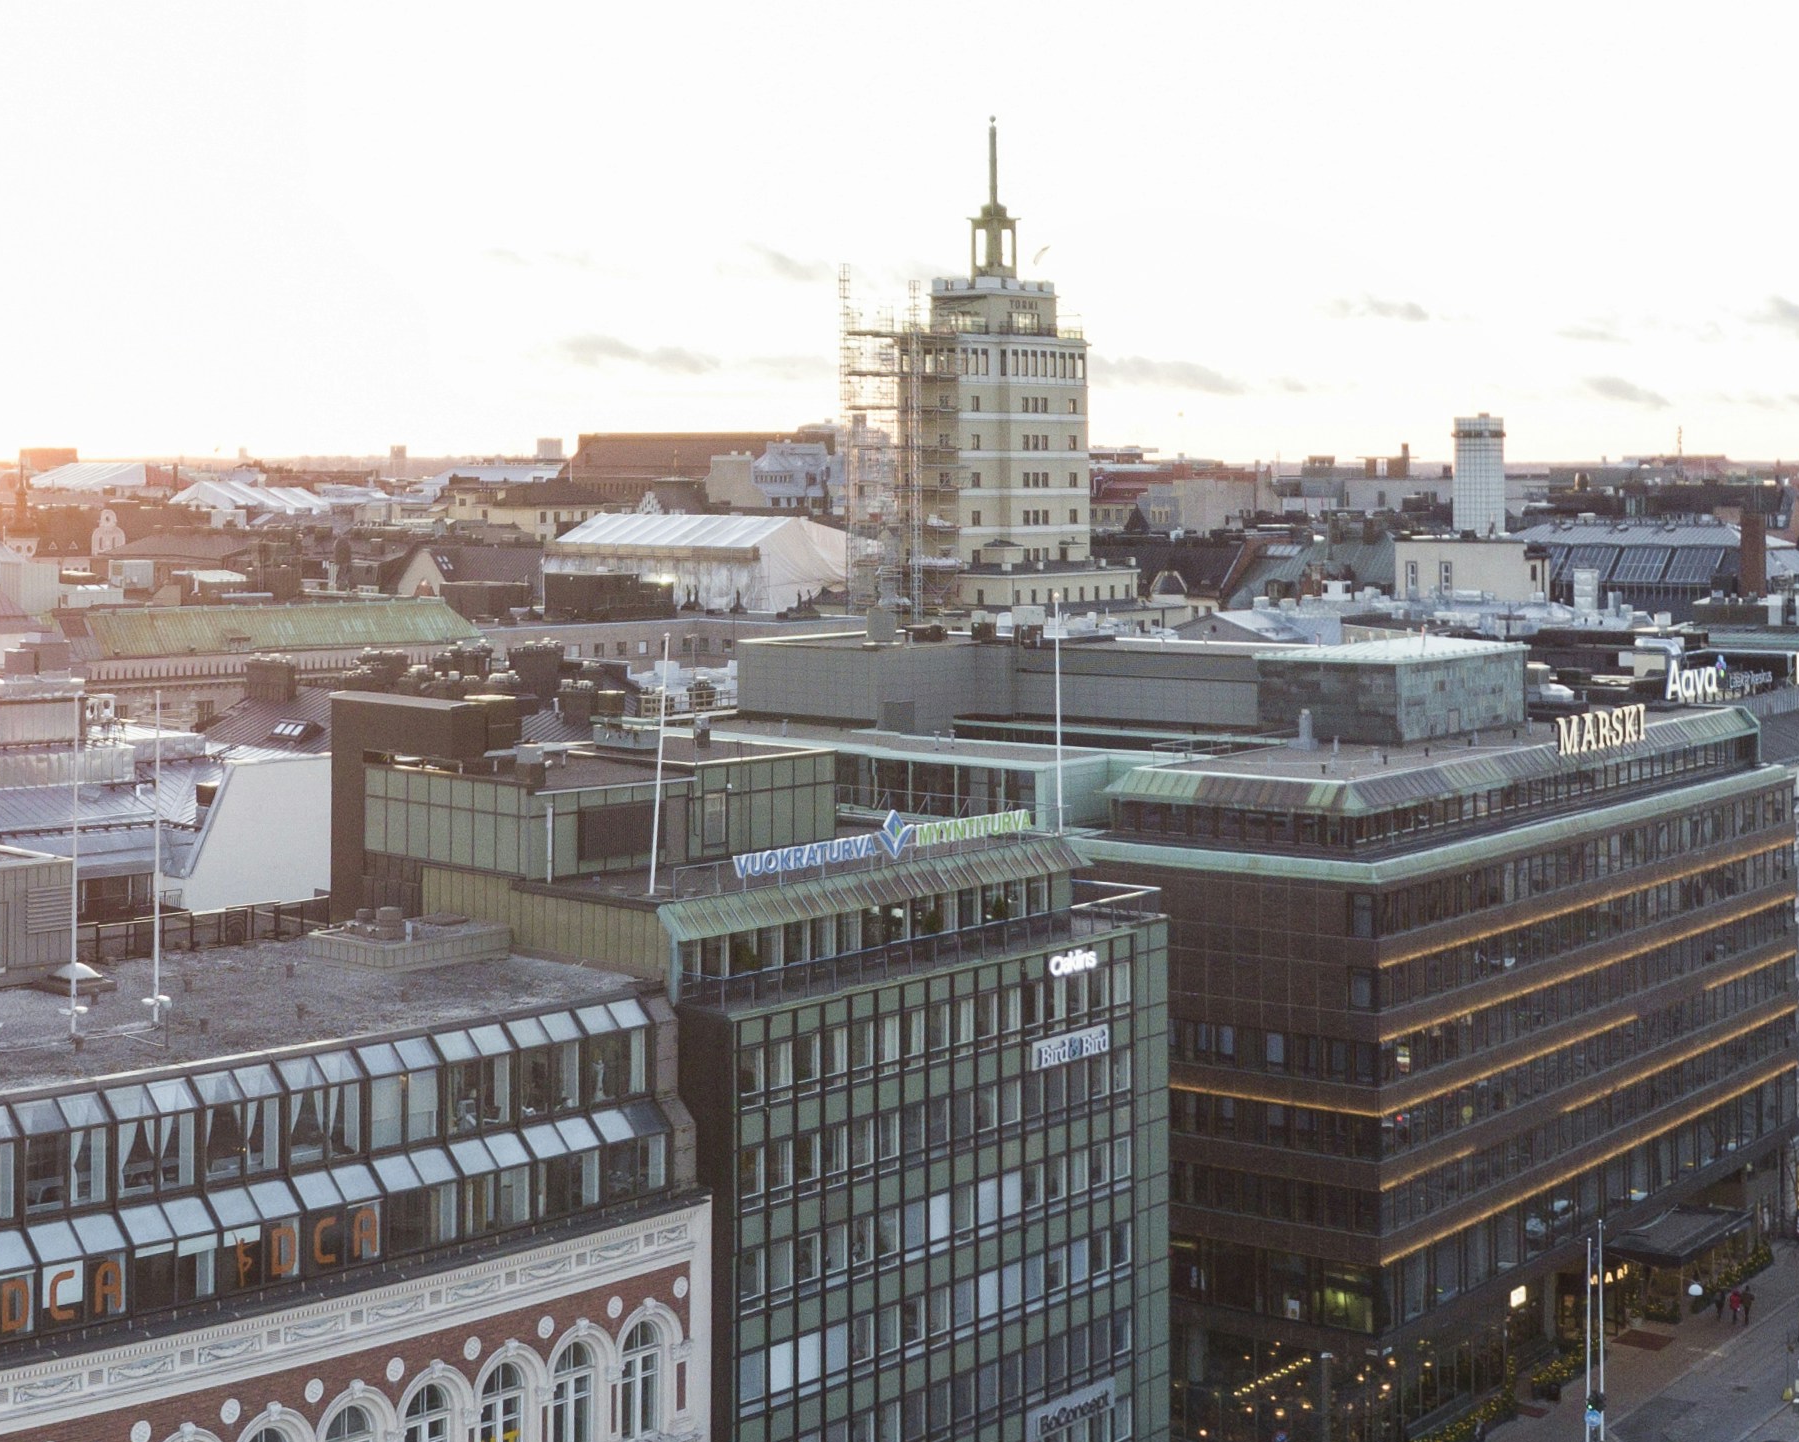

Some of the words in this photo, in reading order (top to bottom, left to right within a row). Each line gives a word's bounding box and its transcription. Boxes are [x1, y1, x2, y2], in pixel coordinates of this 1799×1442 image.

[1666, 660, 1719, 699] Aava
[1556, 703, 1646, 756] MARSKI
[916, 809, 1032, 847] MYYNTITURVA
[733, 834, 876, 879] VUOKRATURVA
[1038, 1040, 1069, 1068] Bird
[1081, 1028, 1109, 1057] Bird
